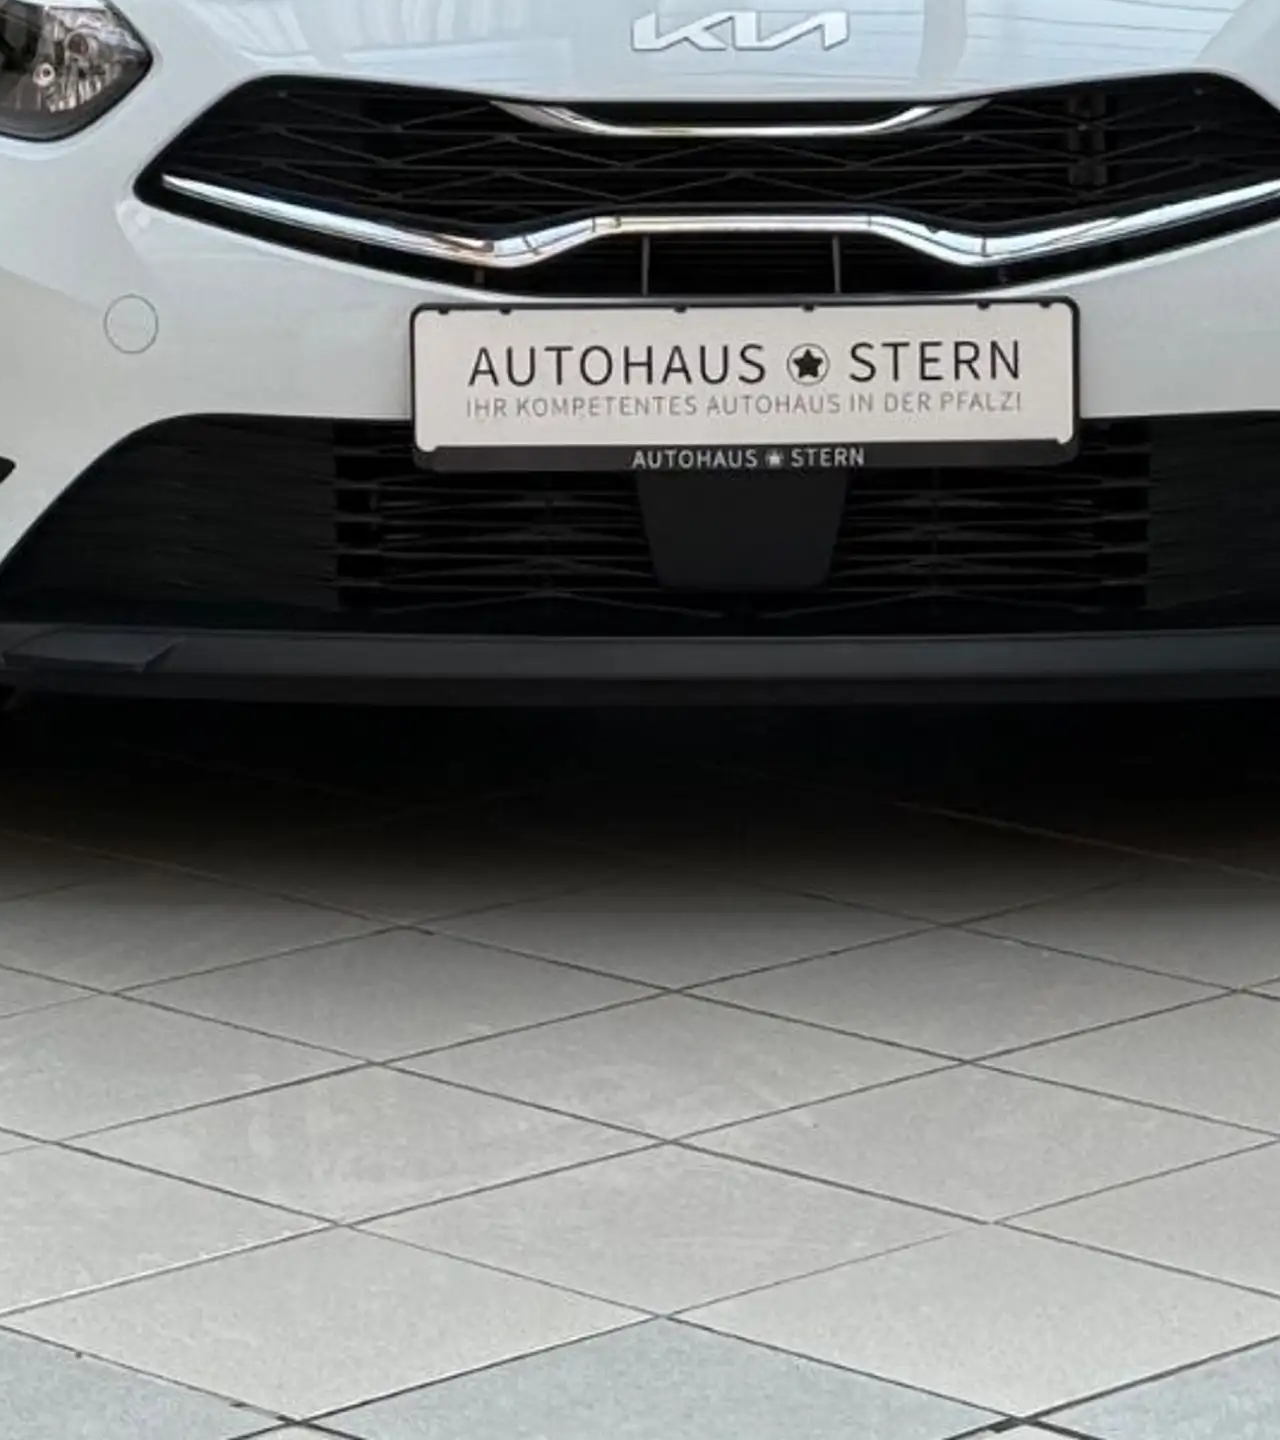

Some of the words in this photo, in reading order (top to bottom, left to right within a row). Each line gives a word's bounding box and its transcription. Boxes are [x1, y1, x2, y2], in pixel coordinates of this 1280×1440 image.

[468, 343, 766, 387] AUTOHAUS
[849, 340, 1019, 383] STERN
[465, 397, 507, 418] IHR
[516, 395, 697, 418] KOMPETENTES
[706, 393, 841, 416] AUTOHAUS
[850, 392, 873, 413] IN
[884, 391, 931, 413] DER
[940, 390, 1021, 412] PFALZ!
[632, 449, 758, 469] AUTOHAUS
[790, 447, 864, 468] STERN
